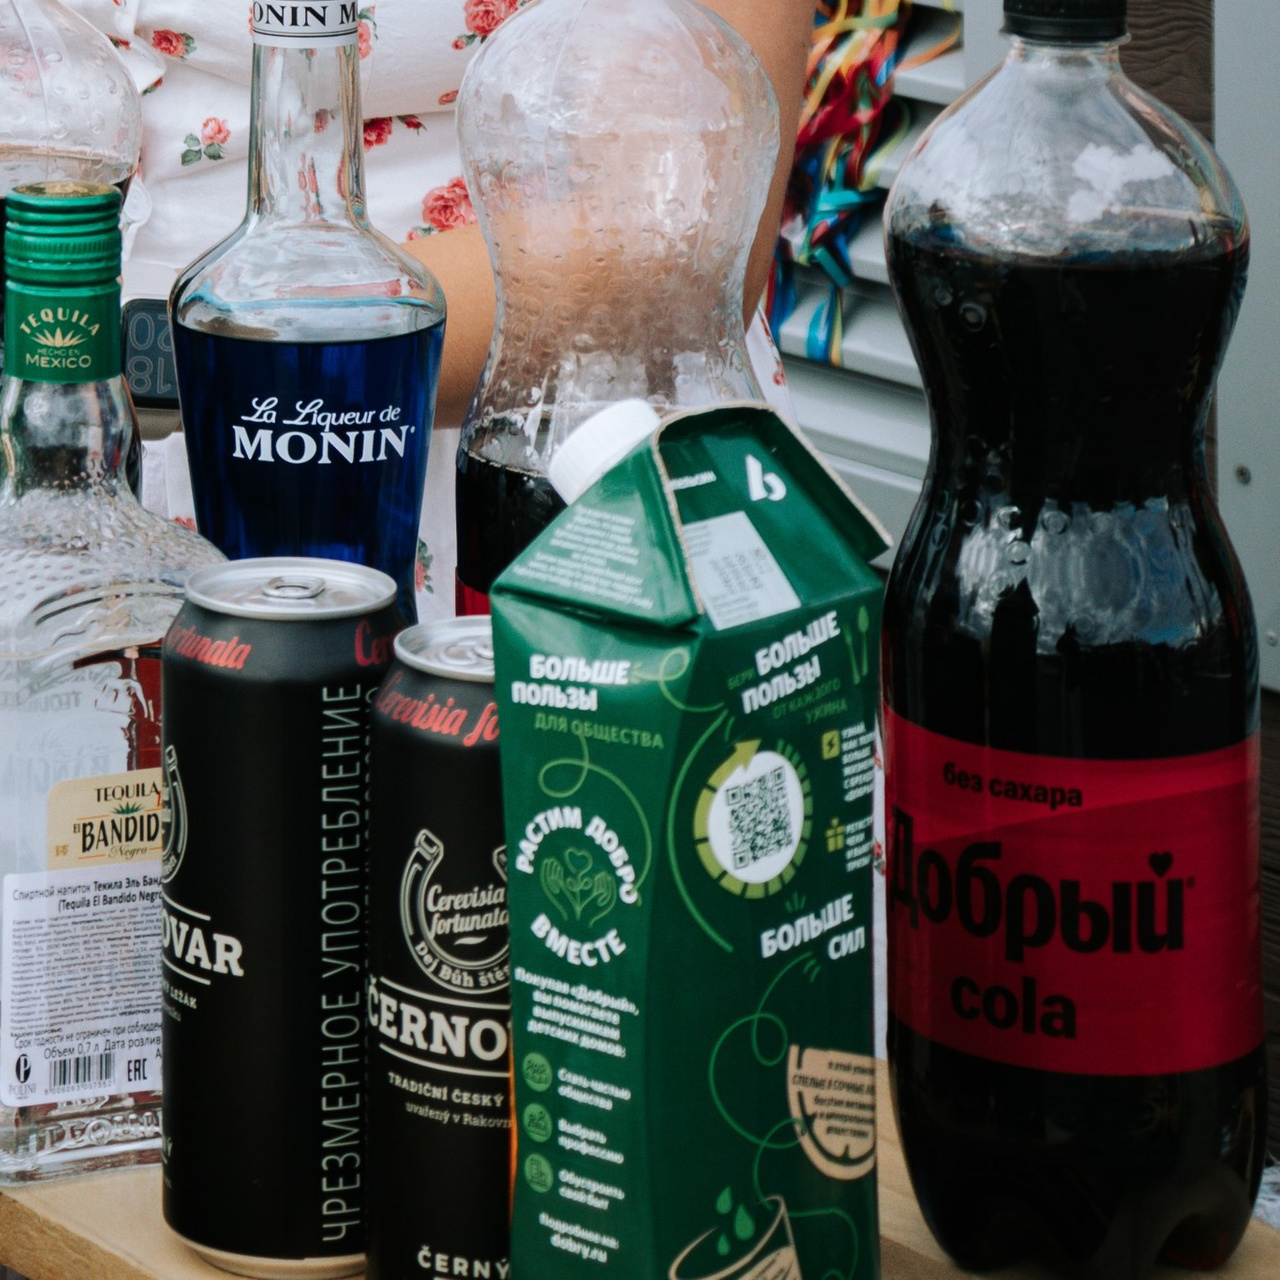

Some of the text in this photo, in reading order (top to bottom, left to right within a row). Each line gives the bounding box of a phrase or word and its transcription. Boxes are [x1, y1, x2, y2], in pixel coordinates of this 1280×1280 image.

[253, 1, 329, 27] ONIN
[20, 307, 100, 336] TEQUILA
[26, 353, 91, 369] MEXICO
[38, 348, 67, 356] HECHO
[241, 397, 401, 432] La Liqueur de
[232, 425, 410, 464] MONIN
[755, 610, 841, 677] БОЛЬШЕ
[529, 653, 631, 686] БОЛЬШЕ
[741, 655, 822, 714] ПОЛЬЗЫ
[510, 680, 599, 712] ПОЛЬЗЫ
[805, 698, 848, 725] УЖИНА
[534, 711, 665, 750] ДЛЯ ОБЩЕСТВА
[94, 781, 160, 803] TEQUILA
[943, 762, 1083, 812] без сахара
[81, 812, 160, 853] BANDID
[321, 684, 361, 979] УПОТРЕБЛЕНИЕ
[108, 843, 148, 860] Negro
[515, 805, 638, 904] РАСТИМ ДОБРО
[13, 885, 55, 901] Спиртной
[93, 879, 123, 891] Текила
[125, 877, 141, 888] Эль
[143, 875, 163, 887] Банд
[426, 884, 506, 912] Cerevisia
[889, 804, 1185, 964] Добрый
[58, 899, 91, 913] (Tequila
[103, 892, 137, 907] Bandido
[162, 908, 245, 977] OVAR
[530, 911, 627, 967] ВМЕСТЕ
[761, 893, 855, 959] БОЛЬШЕ
[827, 926, 865, 960] СИЛ
[414, 941, 510, 988] Dej Bůh štěs
[368, 974, 509, 1062] ČERNO
[951, 975, 1078, 1039] cola
[127, 1020, 163, 1035] соблюден
[44, 1045, 75, 1059] Объем
[103, 1038, 126, 1052] Дата
[128, 1034, 162, 1049] розлив
[127, 1058, 148, 1082] EAC
[388, 1071, 505, 1108] TRADIČNÍ ČESKÝ
[321, 991, 361, 1242] ЧРЕЗМЕРНОЕ
[462, 1112, 513, 1129] Rakovn
[417, 1244, 511, 1280] ČERNÝ
[550, 1233, 608, 1264] dobry.ru
